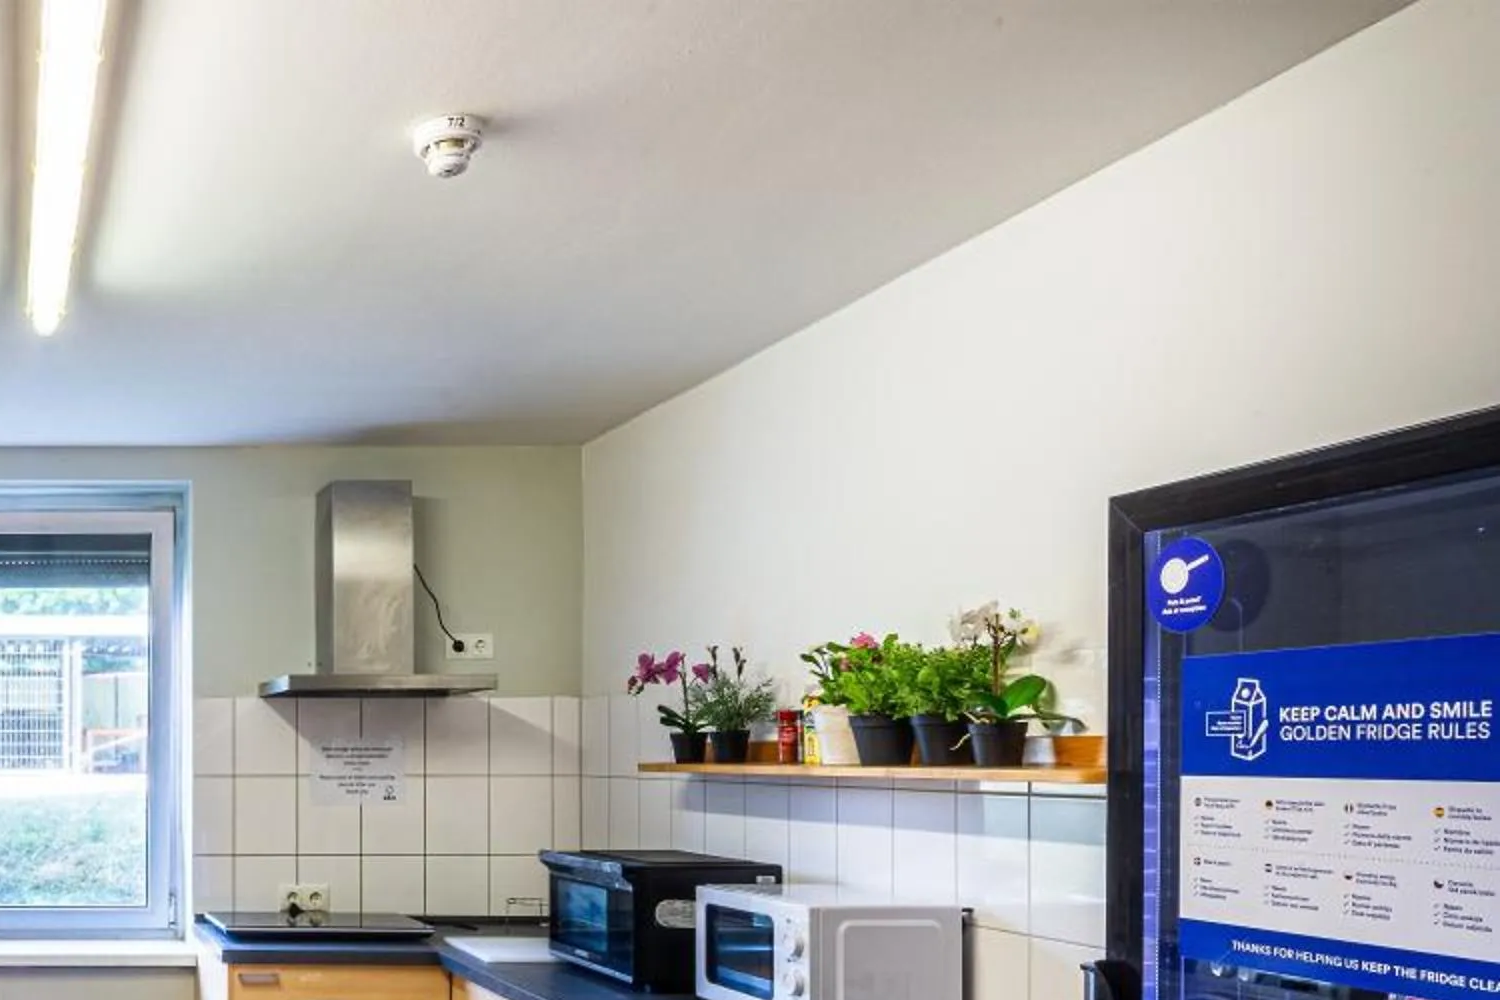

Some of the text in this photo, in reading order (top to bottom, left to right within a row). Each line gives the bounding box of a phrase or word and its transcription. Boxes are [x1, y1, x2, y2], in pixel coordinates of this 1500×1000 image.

[1279, 700, 1492, 722] KEEP CALM AND SMILE
[1280, 721, 1491, 741] GOLDEN FRIDGE RULES
[1232, 940, 1272, 956] THANKS
[1273, 946, 1294, 959] FOR
[1295, 950, 1342, 967] HELPING
[1343, 958, 1359, 971] US
[1361, 960, 1391, 975] KEEP
[1393, 965, 1417, 979] THE
[1420, 969, 1466, 988] FRIDGE
